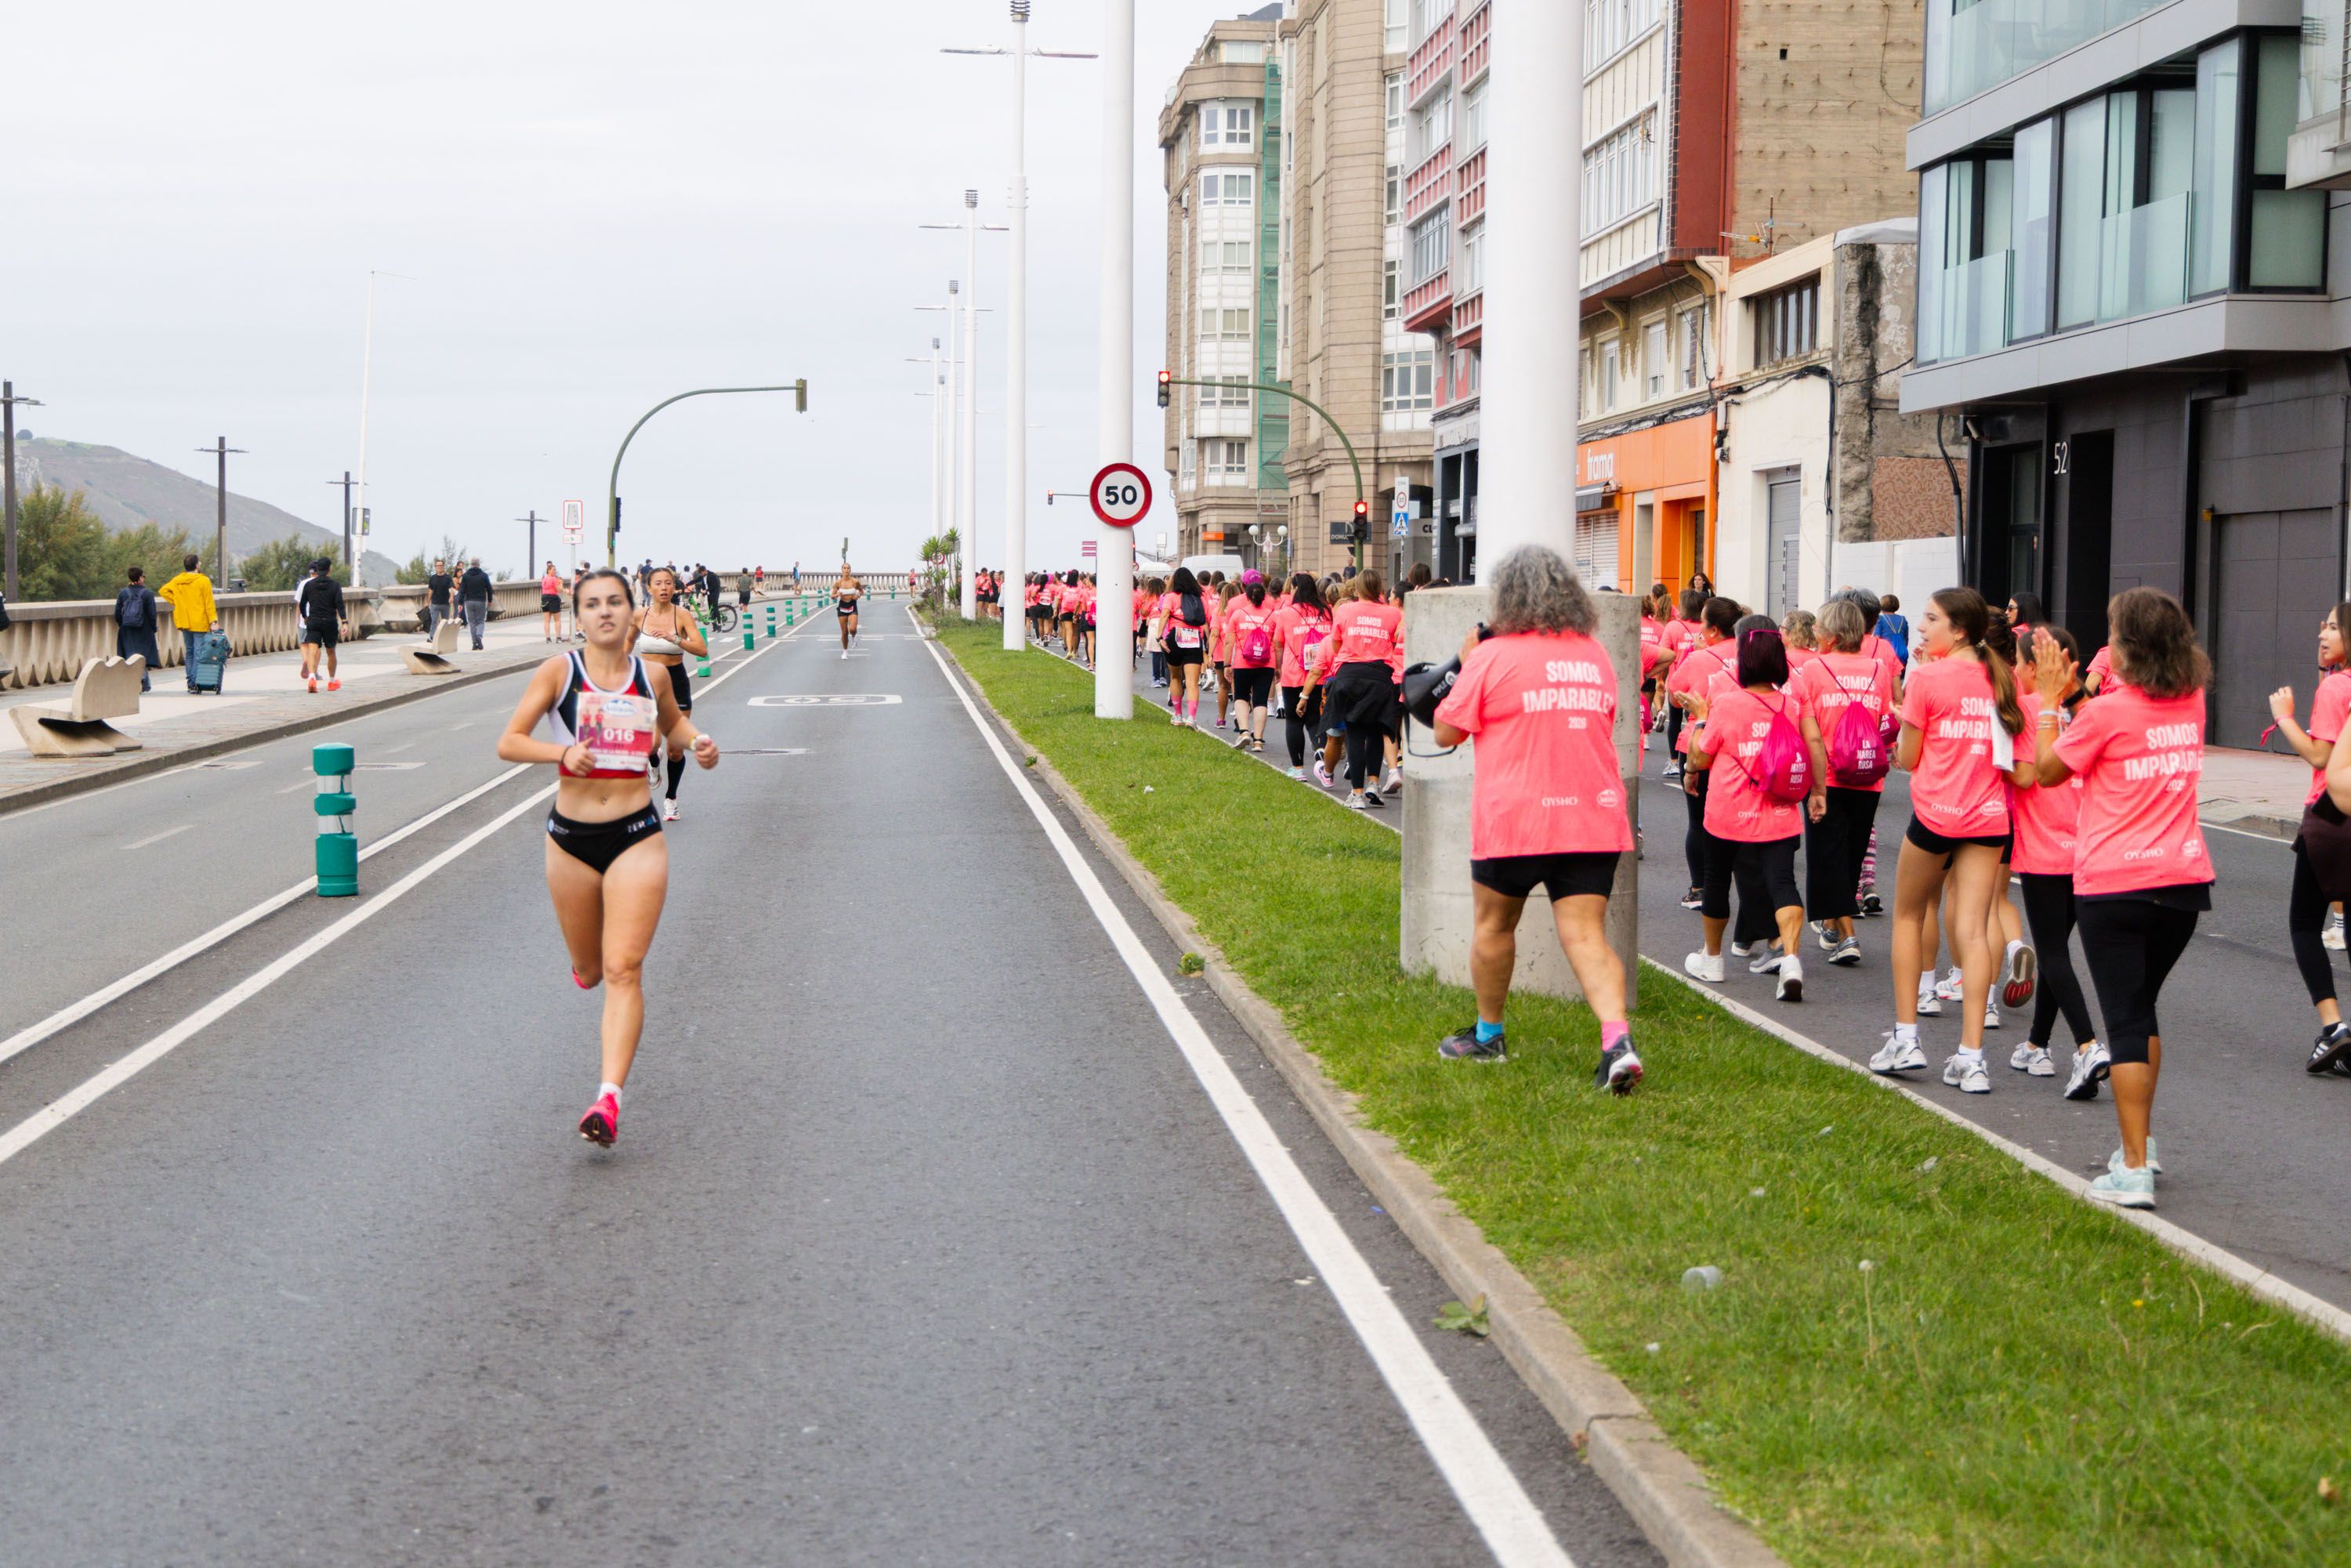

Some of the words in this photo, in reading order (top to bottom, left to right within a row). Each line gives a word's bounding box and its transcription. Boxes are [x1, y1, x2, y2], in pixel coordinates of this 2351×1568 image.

[2054, 441, 2067, 475] 52
[1105, 485, 1137, 505] 50
[1357, 616, 1382, 628] SOMOS
[1348, 627, 1389, 640] IMPARABLES
[1545, 661, 1602, 685] SOMOS
[1836, 675, 1875, 691] SOMOS
[603, 727, 636, 743] 016
[2146, 723, 2198, 750] SOMOS
[1862, 740, 1871, 748] LA
[1858, 760, 1873, 770] ROSA
[1541, 796, 1578, 807] OYSHO
[1931, 802, 1963, 816] OYSHO
[2124, 848, 2164, 860] OYSHO
